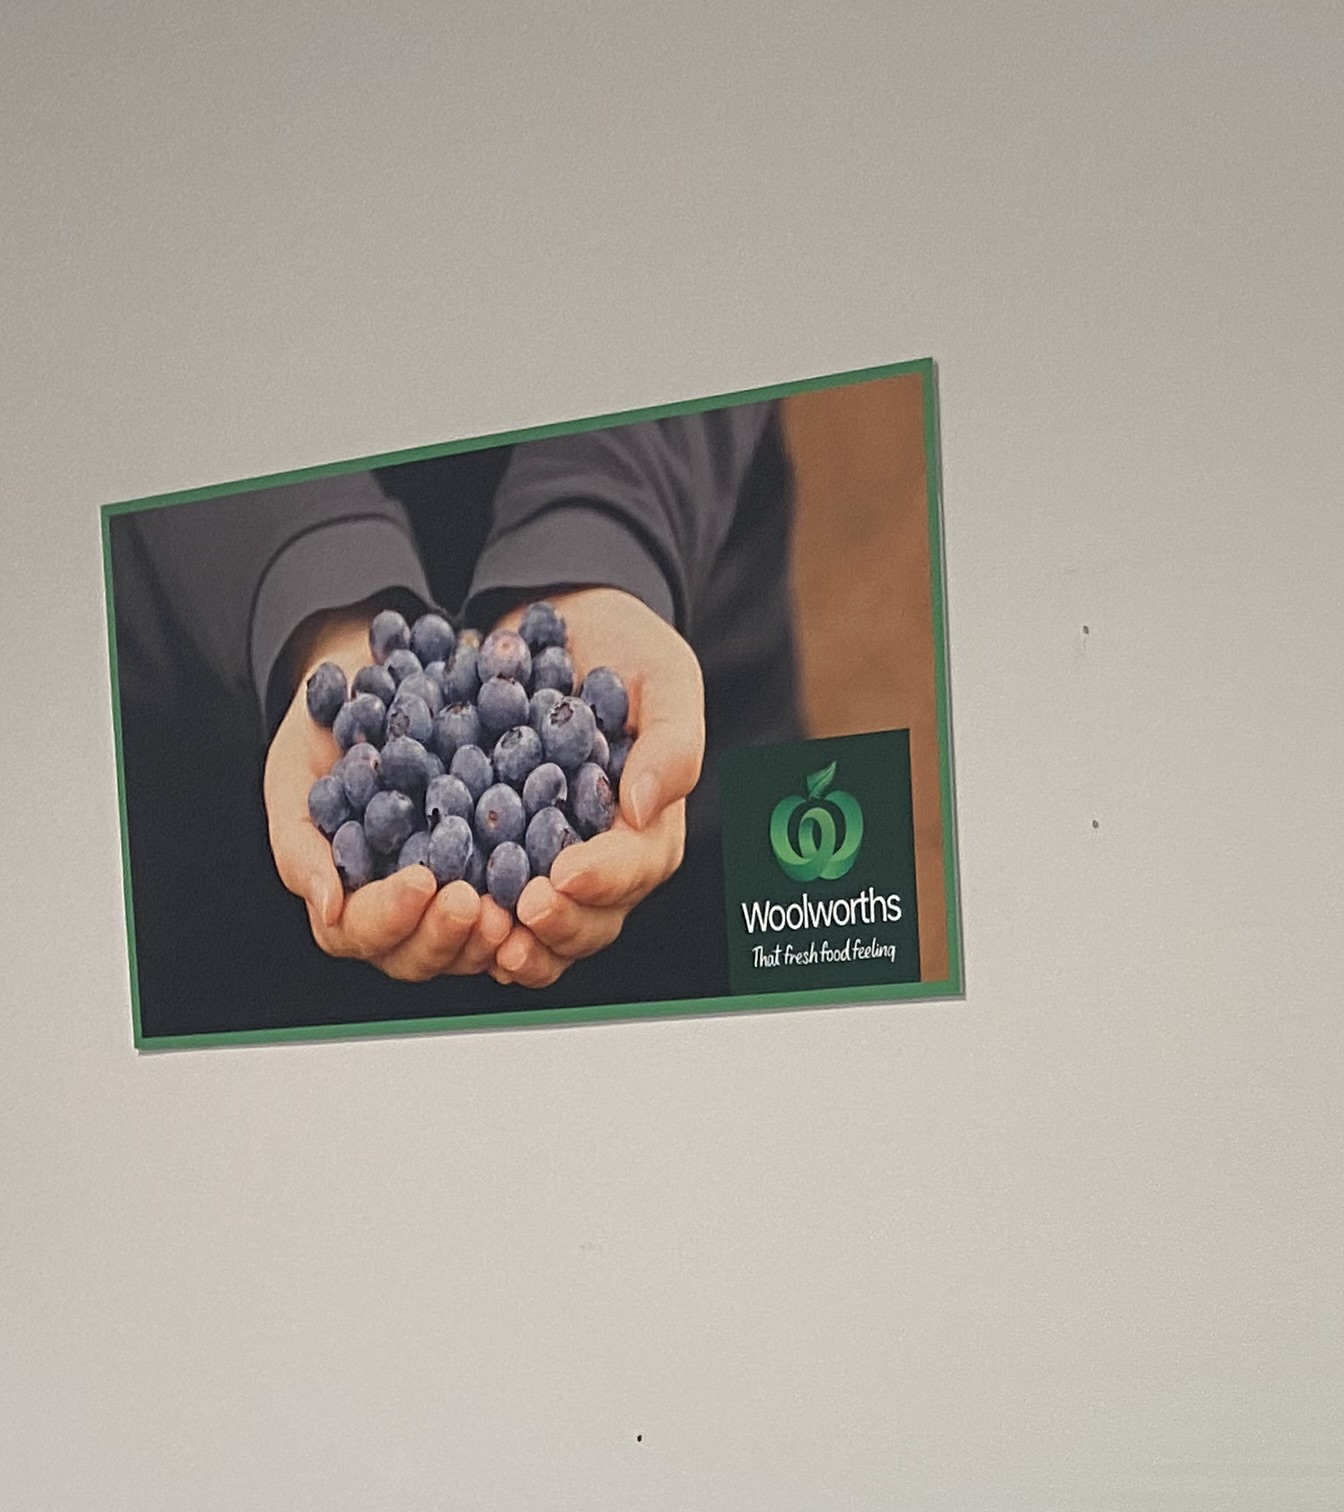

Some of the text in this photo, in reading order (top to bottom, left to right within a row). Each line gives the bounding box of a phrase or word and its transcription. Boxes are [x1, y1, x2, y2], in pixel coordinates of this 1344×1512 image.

[741, 887, 902, 934] Woolworths
[752, 937, 896, 968] That fresh food feeling
